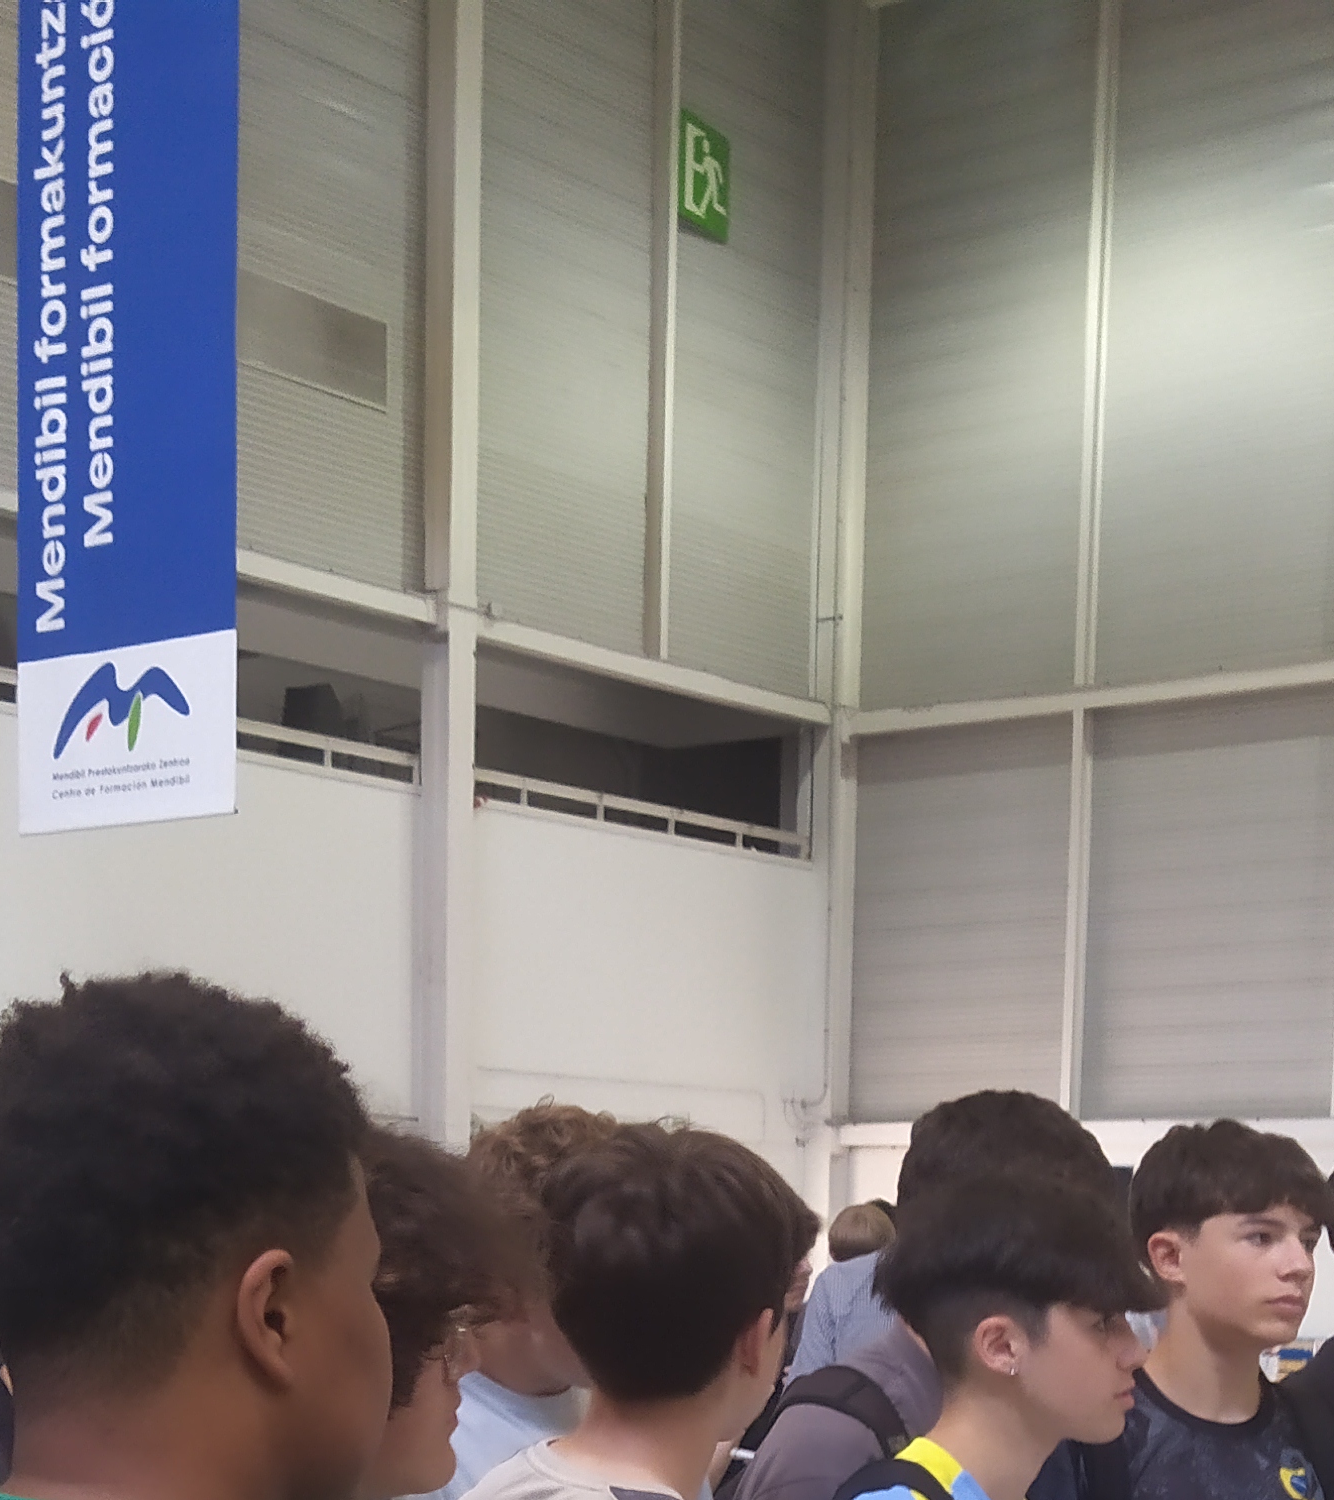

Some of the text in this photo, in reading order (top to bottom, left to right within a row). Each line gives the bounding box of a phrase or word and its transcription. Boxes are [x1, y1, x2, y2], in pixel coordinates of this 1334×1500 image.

[34, 0, 67, 633] Mendibil formakuntz
[81, 284, 114, 548] Mendibil
[85, 786, 96, 796] de
